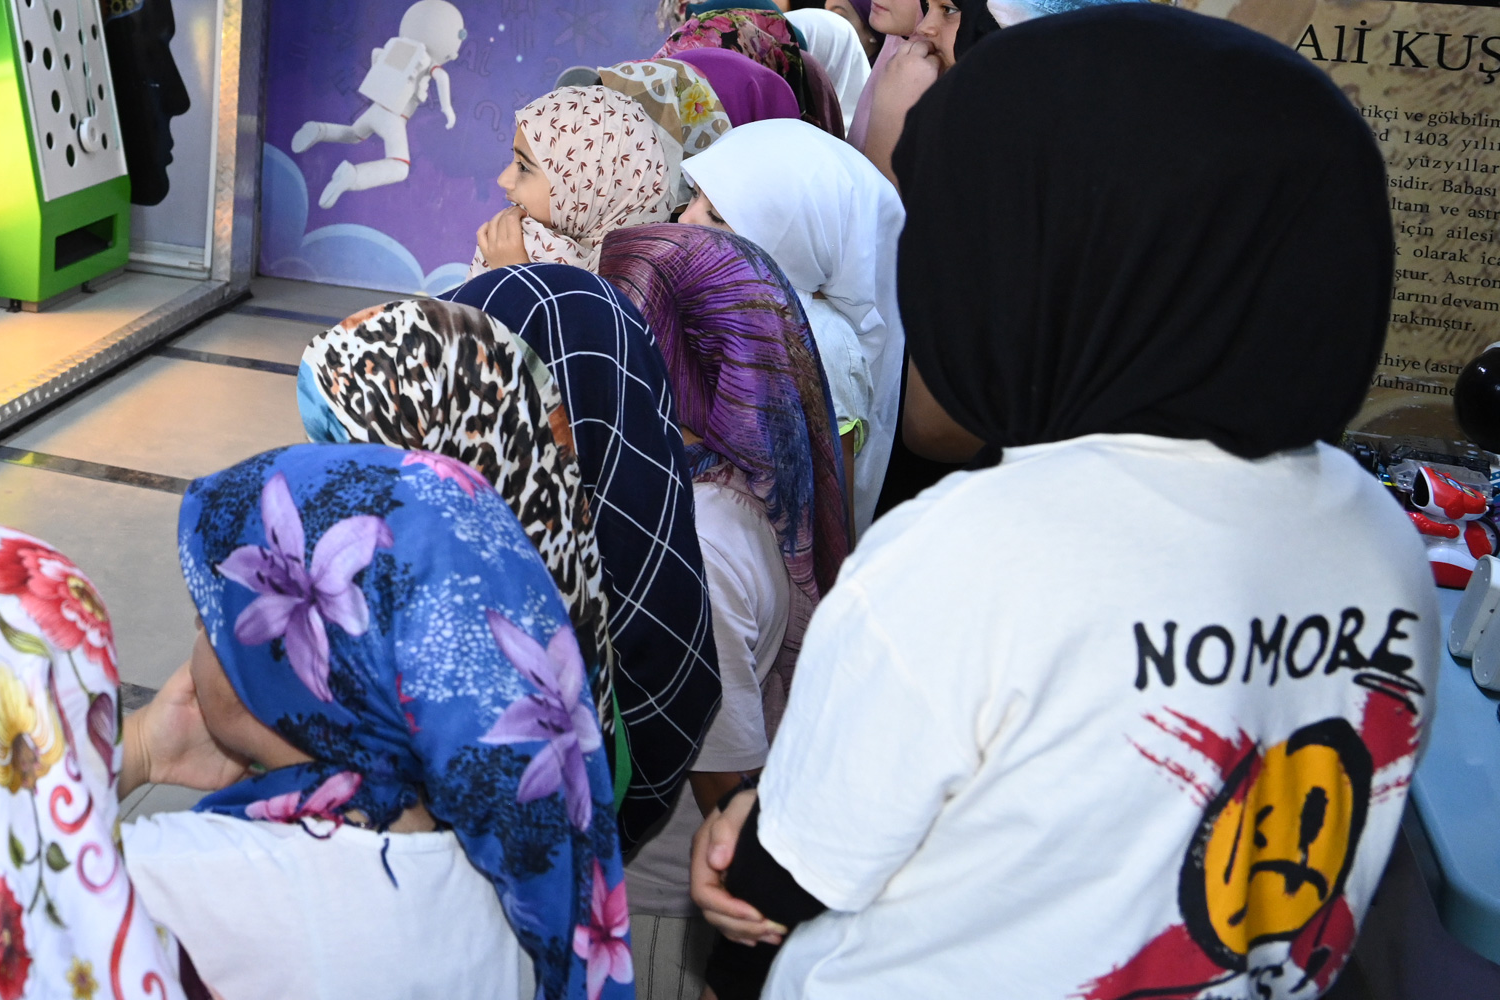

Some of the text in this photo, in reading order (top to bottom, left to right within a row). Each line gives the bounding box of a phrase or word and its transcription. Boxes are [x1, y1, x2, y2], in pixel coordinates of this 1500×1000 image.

[1404, 112, 1424, 121] ve
[1404, 131, 1448, 146] 1403
[1442, 180, 1497, 197] Babası
[1440, 206, 1460, 216] ve
[1400, 220, 1494, 243] için ailesi
[1413, 245, 1469, 263] olarak
[1442, 293, 1499, 312] devam
